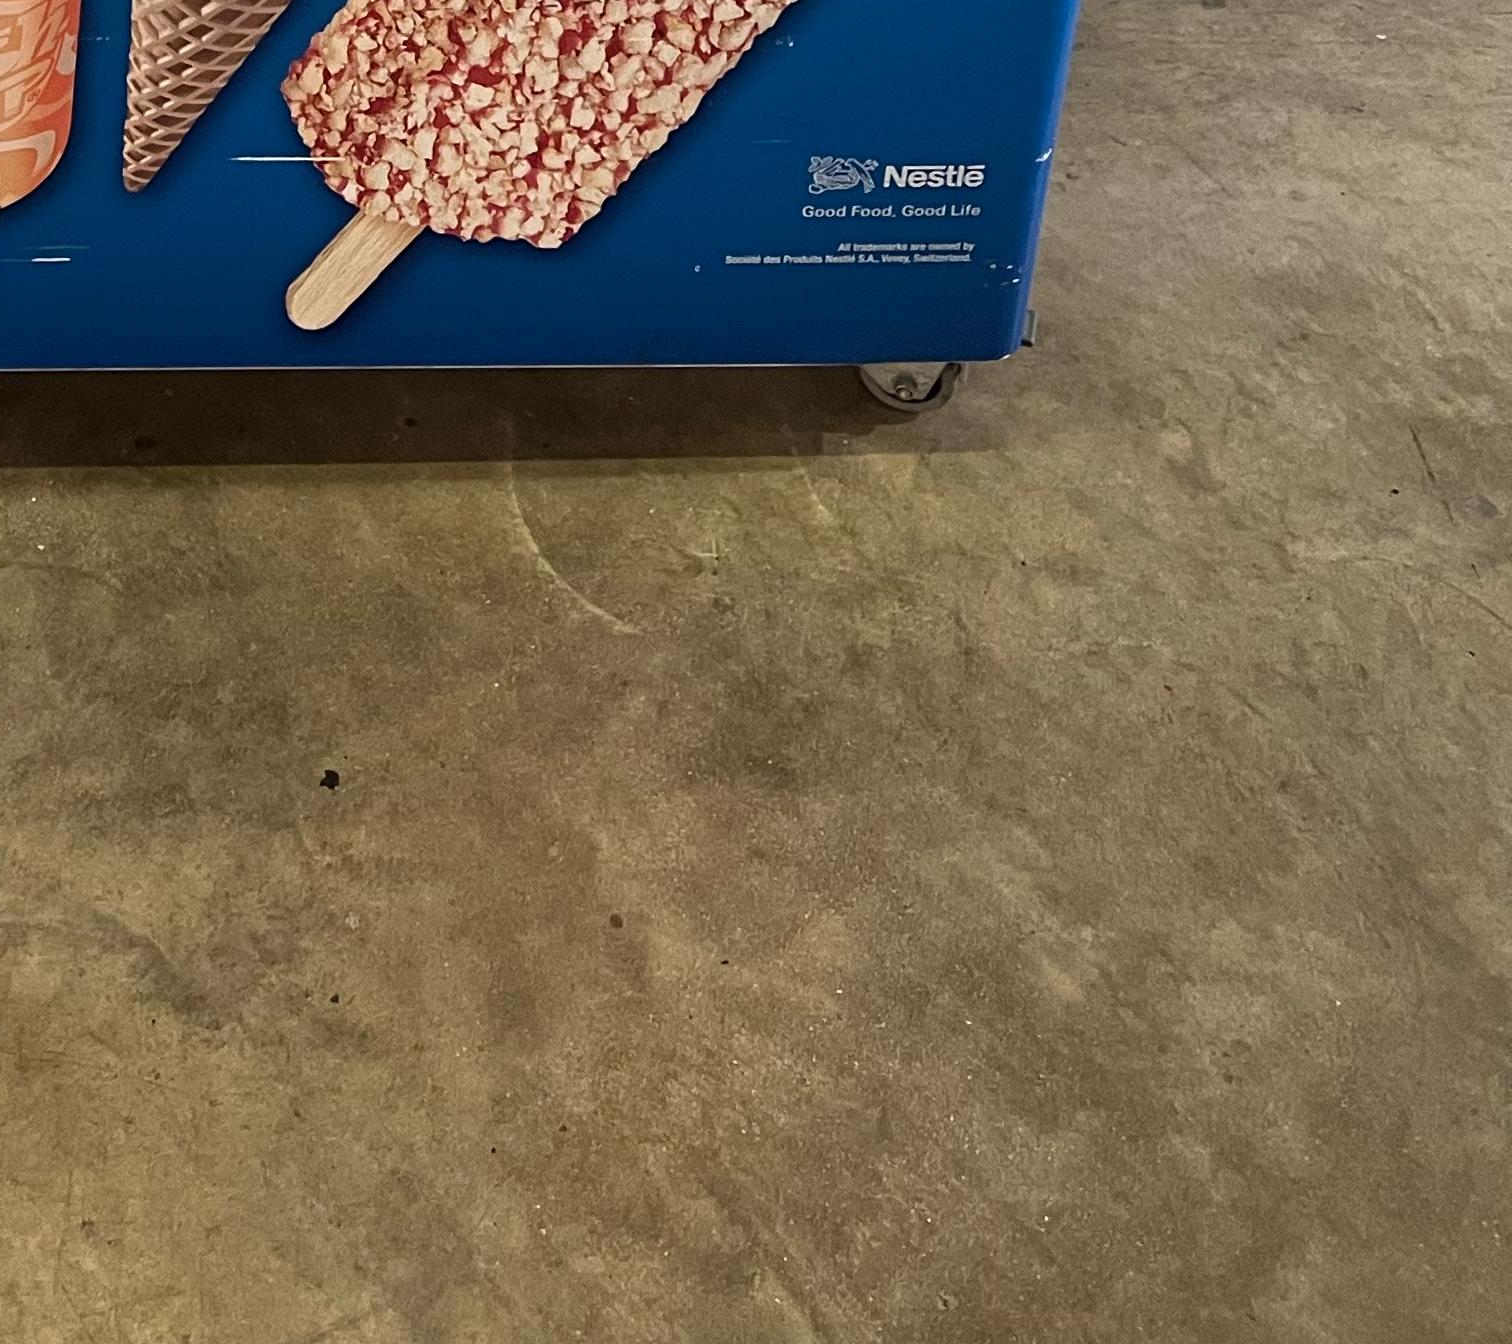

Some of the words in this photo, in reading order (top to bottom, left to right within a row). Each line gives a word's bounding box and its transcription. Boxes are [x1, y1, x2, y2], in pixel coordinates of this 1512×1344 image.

[883, 165, 985, 188] Nestlé
[802, 205, 846, 218] Good
[901, 204, 946, 217] Good
[951, 203, 981, 216] Life
